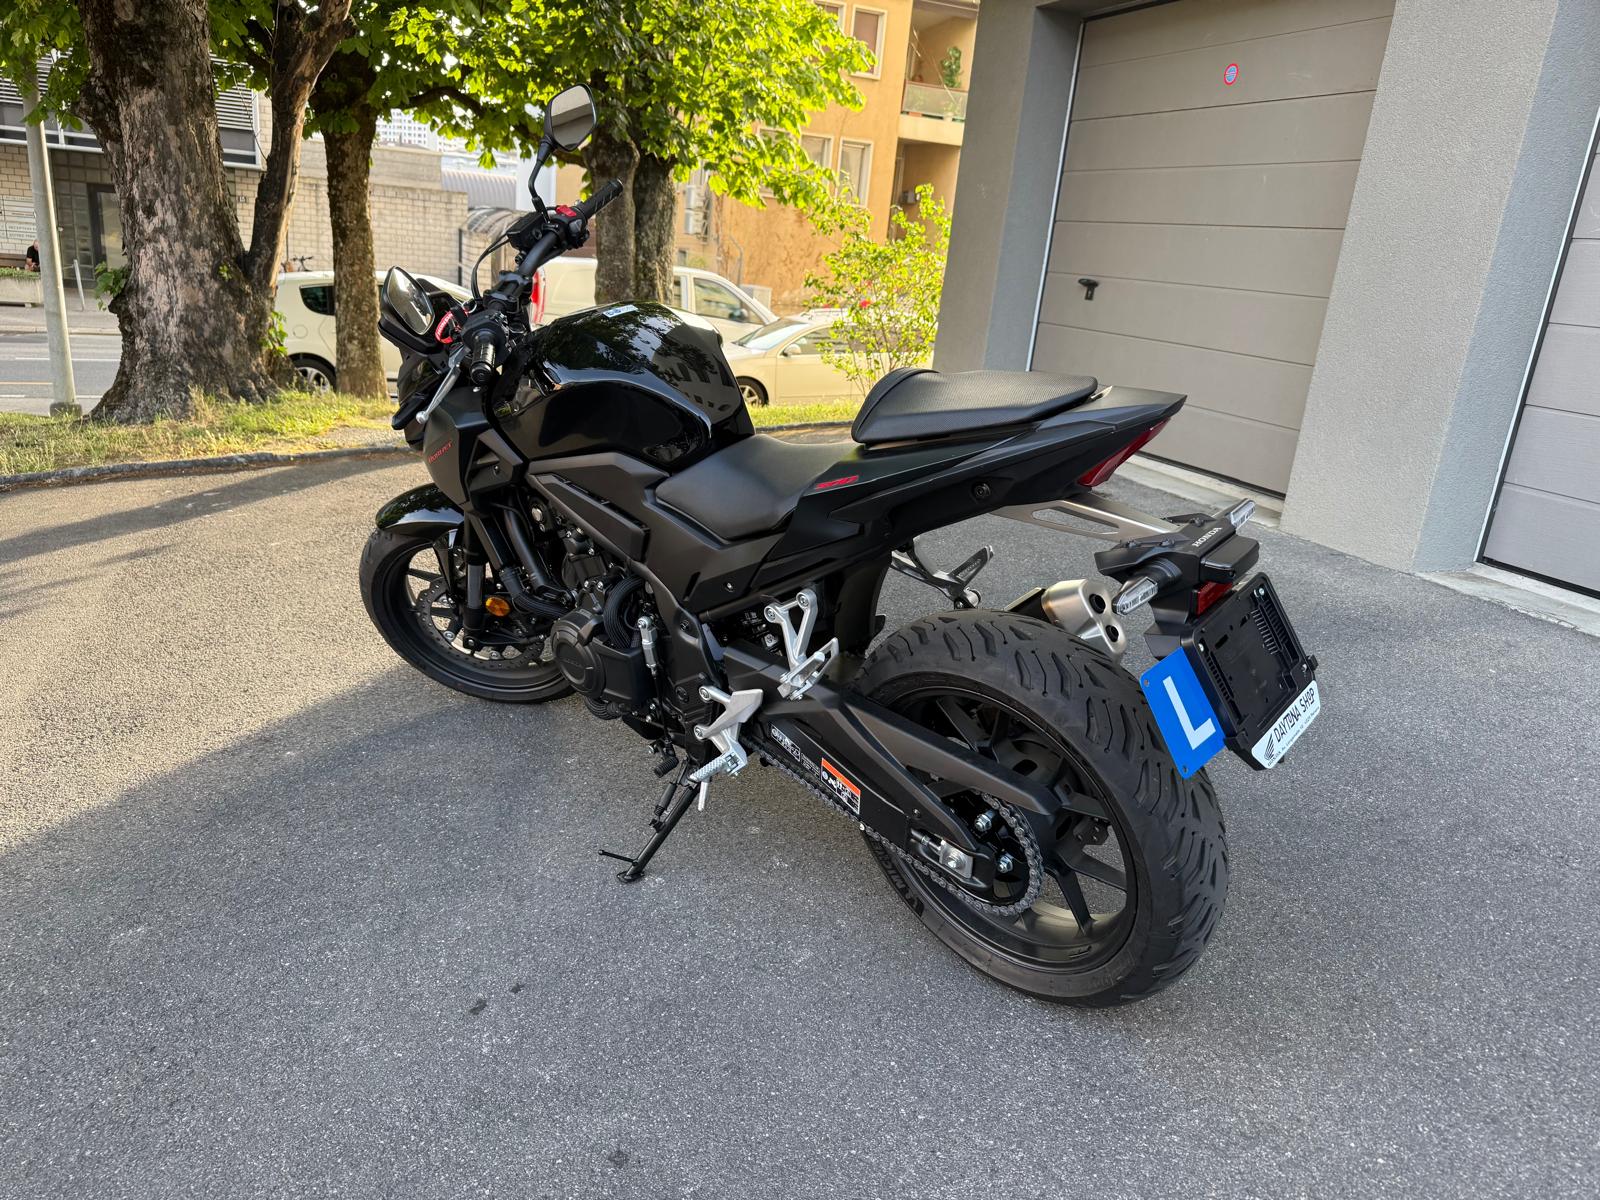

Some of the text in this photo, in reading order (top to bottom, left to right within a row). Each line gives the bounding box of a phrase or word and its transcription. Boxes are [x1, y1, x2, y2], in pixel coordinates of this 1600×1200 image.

[1192, 527, 1222, 547] HONDA
[1162, 675, 1216, 751] L
[1273, 704, 1302, 743] DAYTONA
[1299, 687, 1315, 713] SHOP
